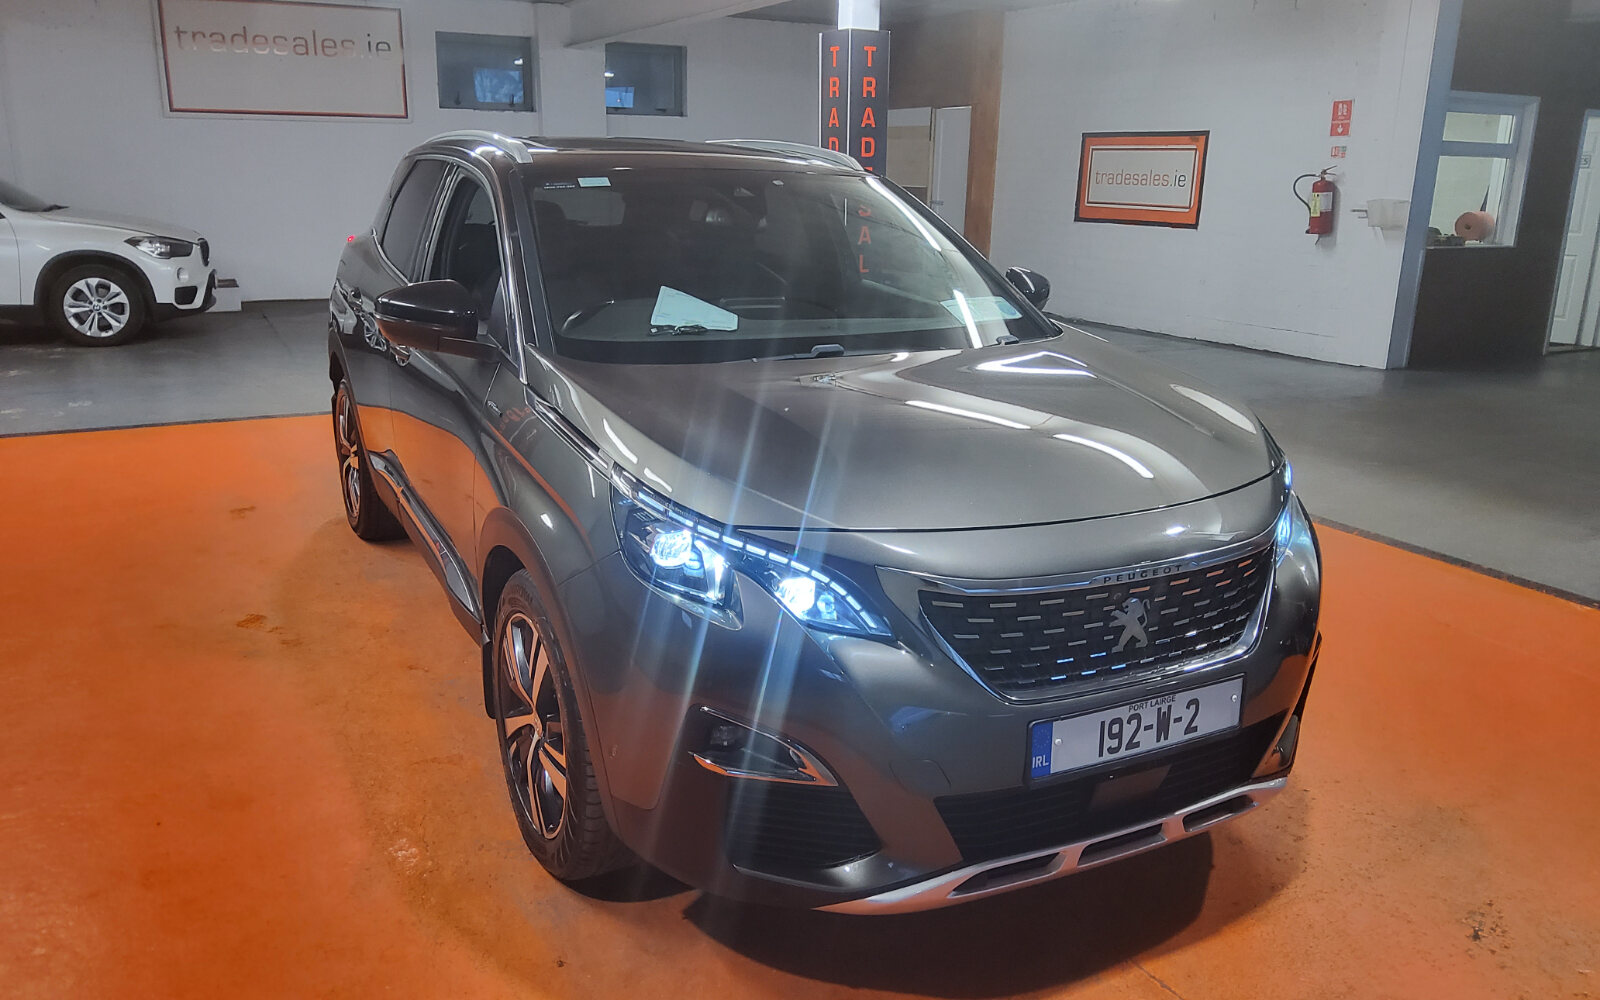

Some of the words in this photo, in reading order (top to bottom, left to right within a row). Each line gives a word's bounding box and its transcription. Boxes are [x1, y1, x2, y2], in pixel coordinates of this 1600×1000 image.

[174, 26, 392, 58] tradesales.ie
[861, 46, 876, 171] TRAD
[1095, 168, 1187, 188] tradesales.ie
[1103, 564, 1182, 585] PEUGEOT
[1128, 701, 1149, 713] PORT
[1098, 698, 1200, 757] 192-W-2
[1032, 754, 1050, 769] IRL
